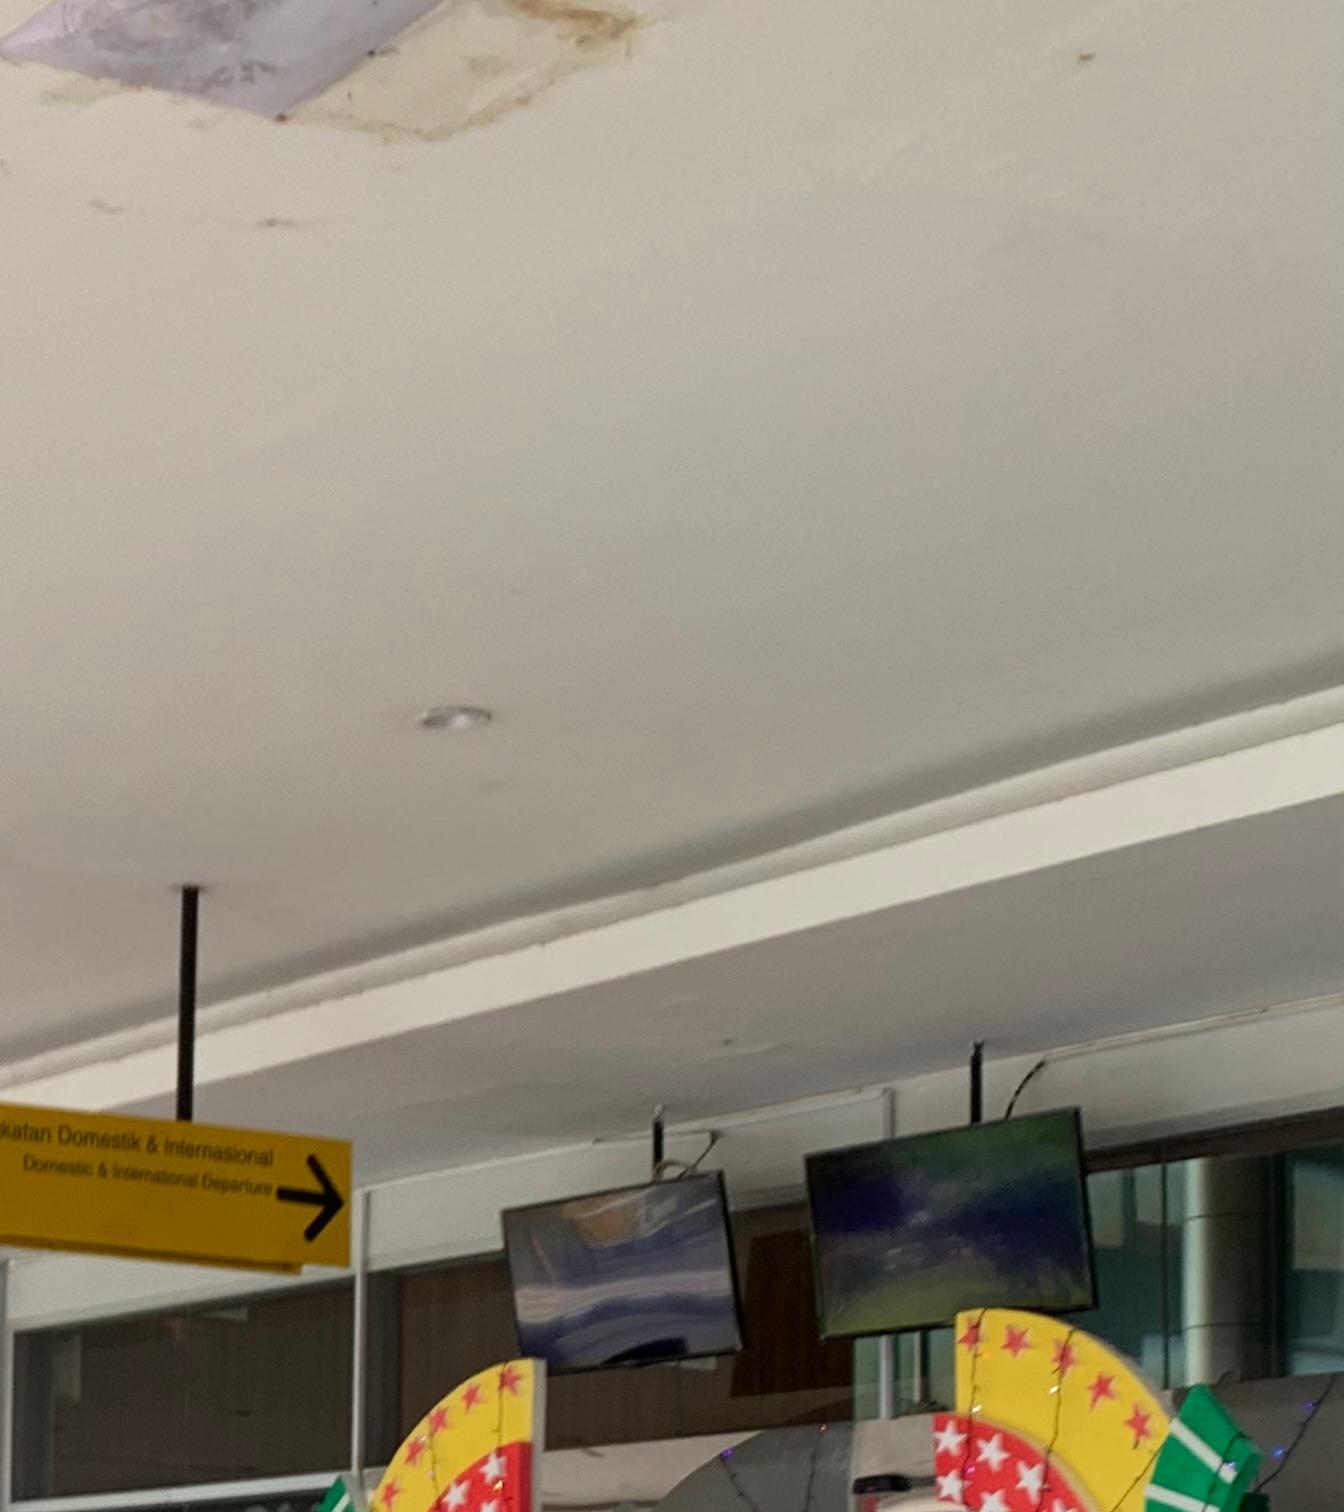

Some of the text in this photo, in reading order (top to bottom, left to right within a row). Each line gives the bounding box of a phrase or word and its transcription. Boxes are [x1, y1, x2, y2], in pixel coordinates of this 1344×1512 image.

[57, 1123, 141, 1151] Domestik
[146, 1135, 158, 1153] &
[163, 1136, 274, 1168] Internasional
[23, 1153, 273, 1196] Domestic & International Departure
